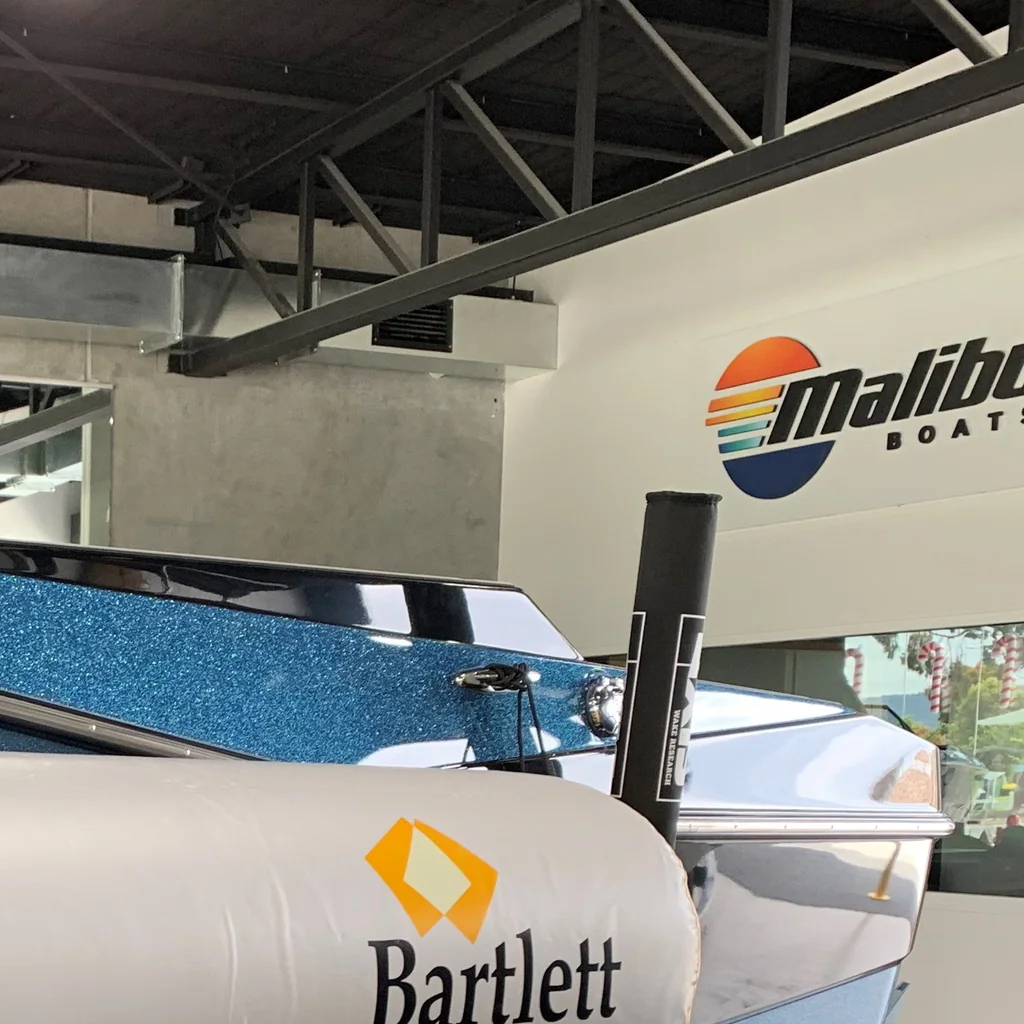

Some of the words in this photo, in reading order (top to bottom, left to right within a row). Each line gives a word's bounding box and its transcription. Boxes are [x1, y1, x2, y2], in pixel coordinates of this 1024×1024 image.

[887, 408, 1024, 450] BOAT
[670, 709, 682, 742] WAKE
[664, 742, 678, 787] RESEARCH
